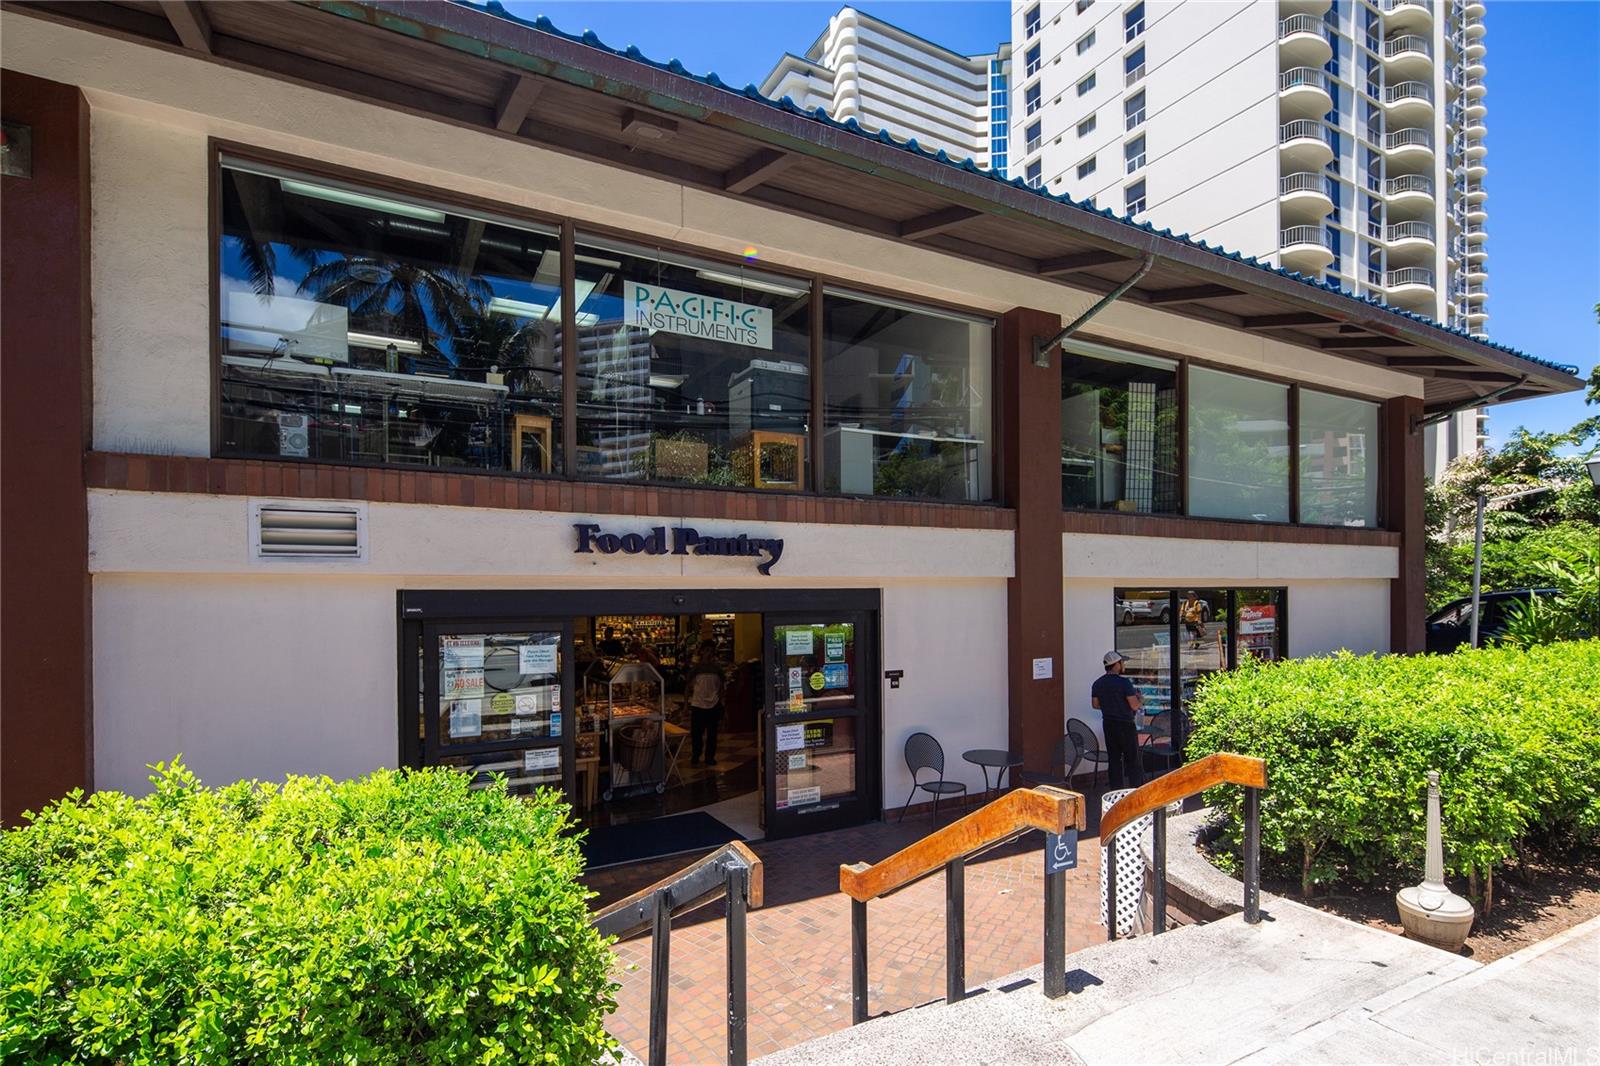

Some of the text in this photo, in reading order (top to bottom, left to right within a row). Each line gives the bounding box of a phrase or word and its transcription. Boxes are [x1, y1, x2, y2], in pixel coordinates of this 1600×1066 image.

[635, 309, 758, 345] INSTRUMENTS
[573, 524, 784, 576] Food Pantry
[466, 677, 484, 688] SALE
